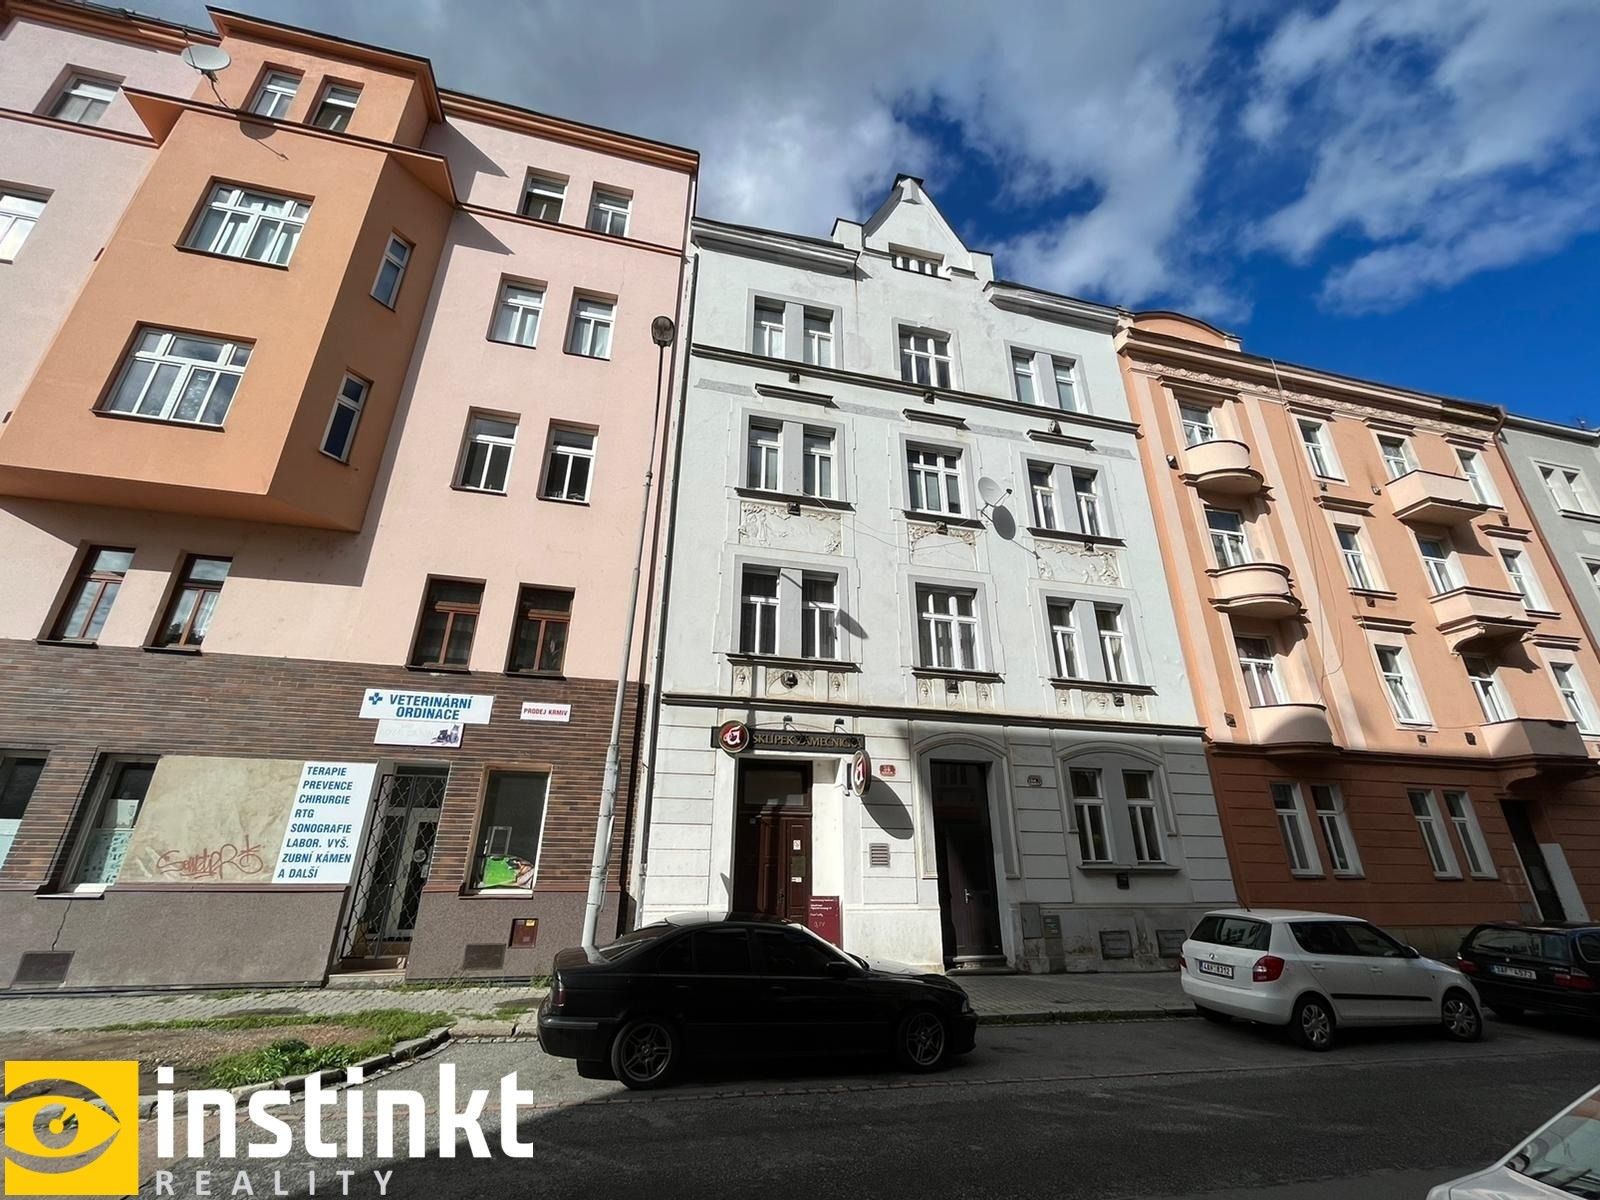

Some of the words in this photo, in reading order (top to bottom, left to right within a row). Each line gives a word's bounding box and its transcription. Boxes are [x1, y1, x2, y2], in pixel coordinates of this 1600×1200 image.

[389, 694, 473, 709] VETERINÁRNÍ
[396, 706, 460, 720] ORDINACE
[523, 707, 547, 715] PRODEJ
[548, 708, 568, 716] KRMIV
[753, 732, 794, 745] SKLÍPEK
[307, 766, 347, 776] TERAPIE
[302, 780, 353, 791] PREVENCE
[298, 794, 351, 805] CHIRURGIE
[295, 808, 315, 818] RTG
[290, 823, 352, 834] SONOGRAFIE
[286, 838, 322, 848] LABOR.
[327, 836, 349, 848] VYŠ.
[281, 851, 314, 863] ZUBNÍ
[315, 850, 351, 864] KÁMEN
[277, 868, 285, 879] A
[288, 865, 320, 879] DALŠÍ
